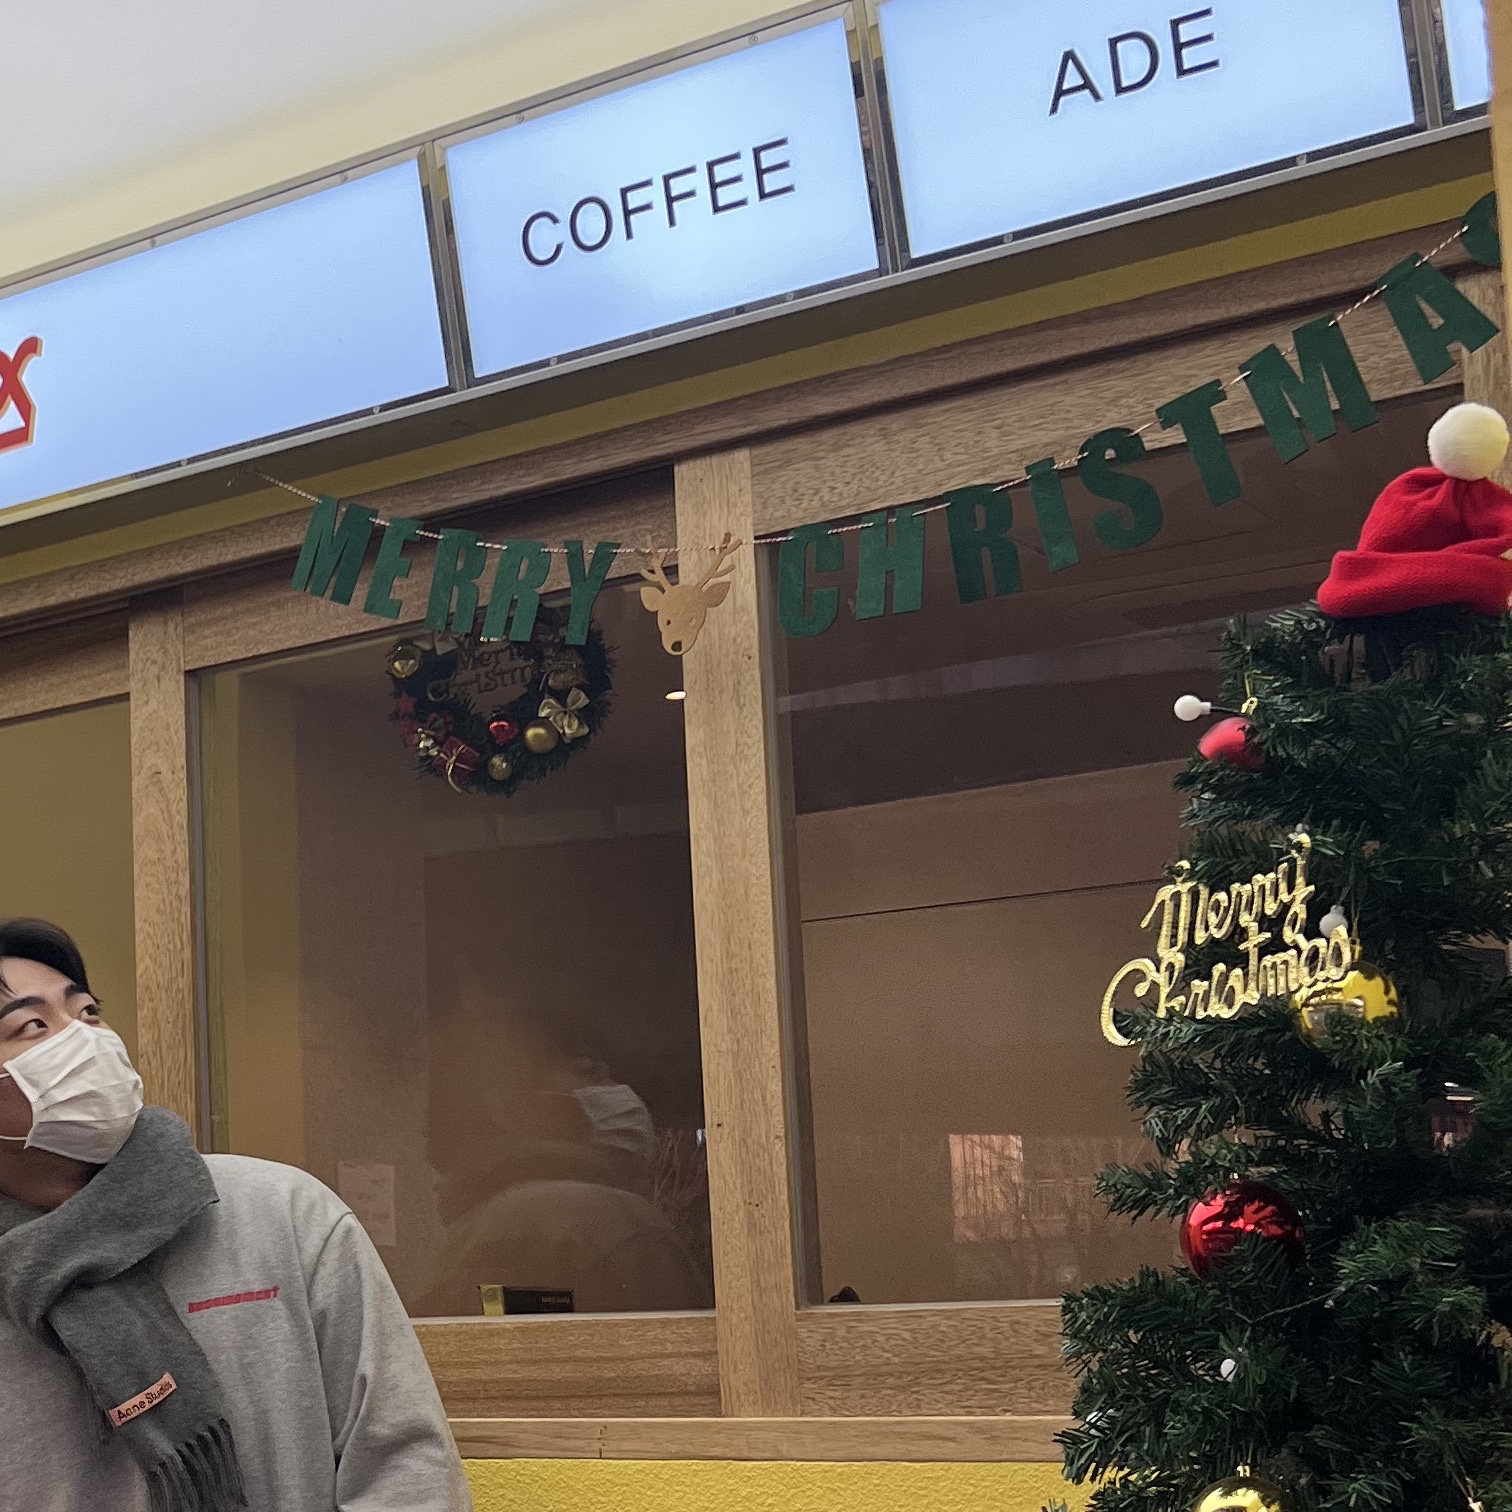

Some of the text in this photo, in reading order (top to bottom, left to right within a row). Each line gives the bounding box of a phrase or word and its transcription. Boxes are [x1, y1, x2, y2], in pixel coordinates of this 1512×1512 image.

[1048, 6, 1221, 116] ADE
[519, 136, 797, 268] COFFEE
[291, 496, 621, 645] MERRY
[1140, 850, 1316, 950] Merry
[1099, 922, 1352, 1047] Christmas
